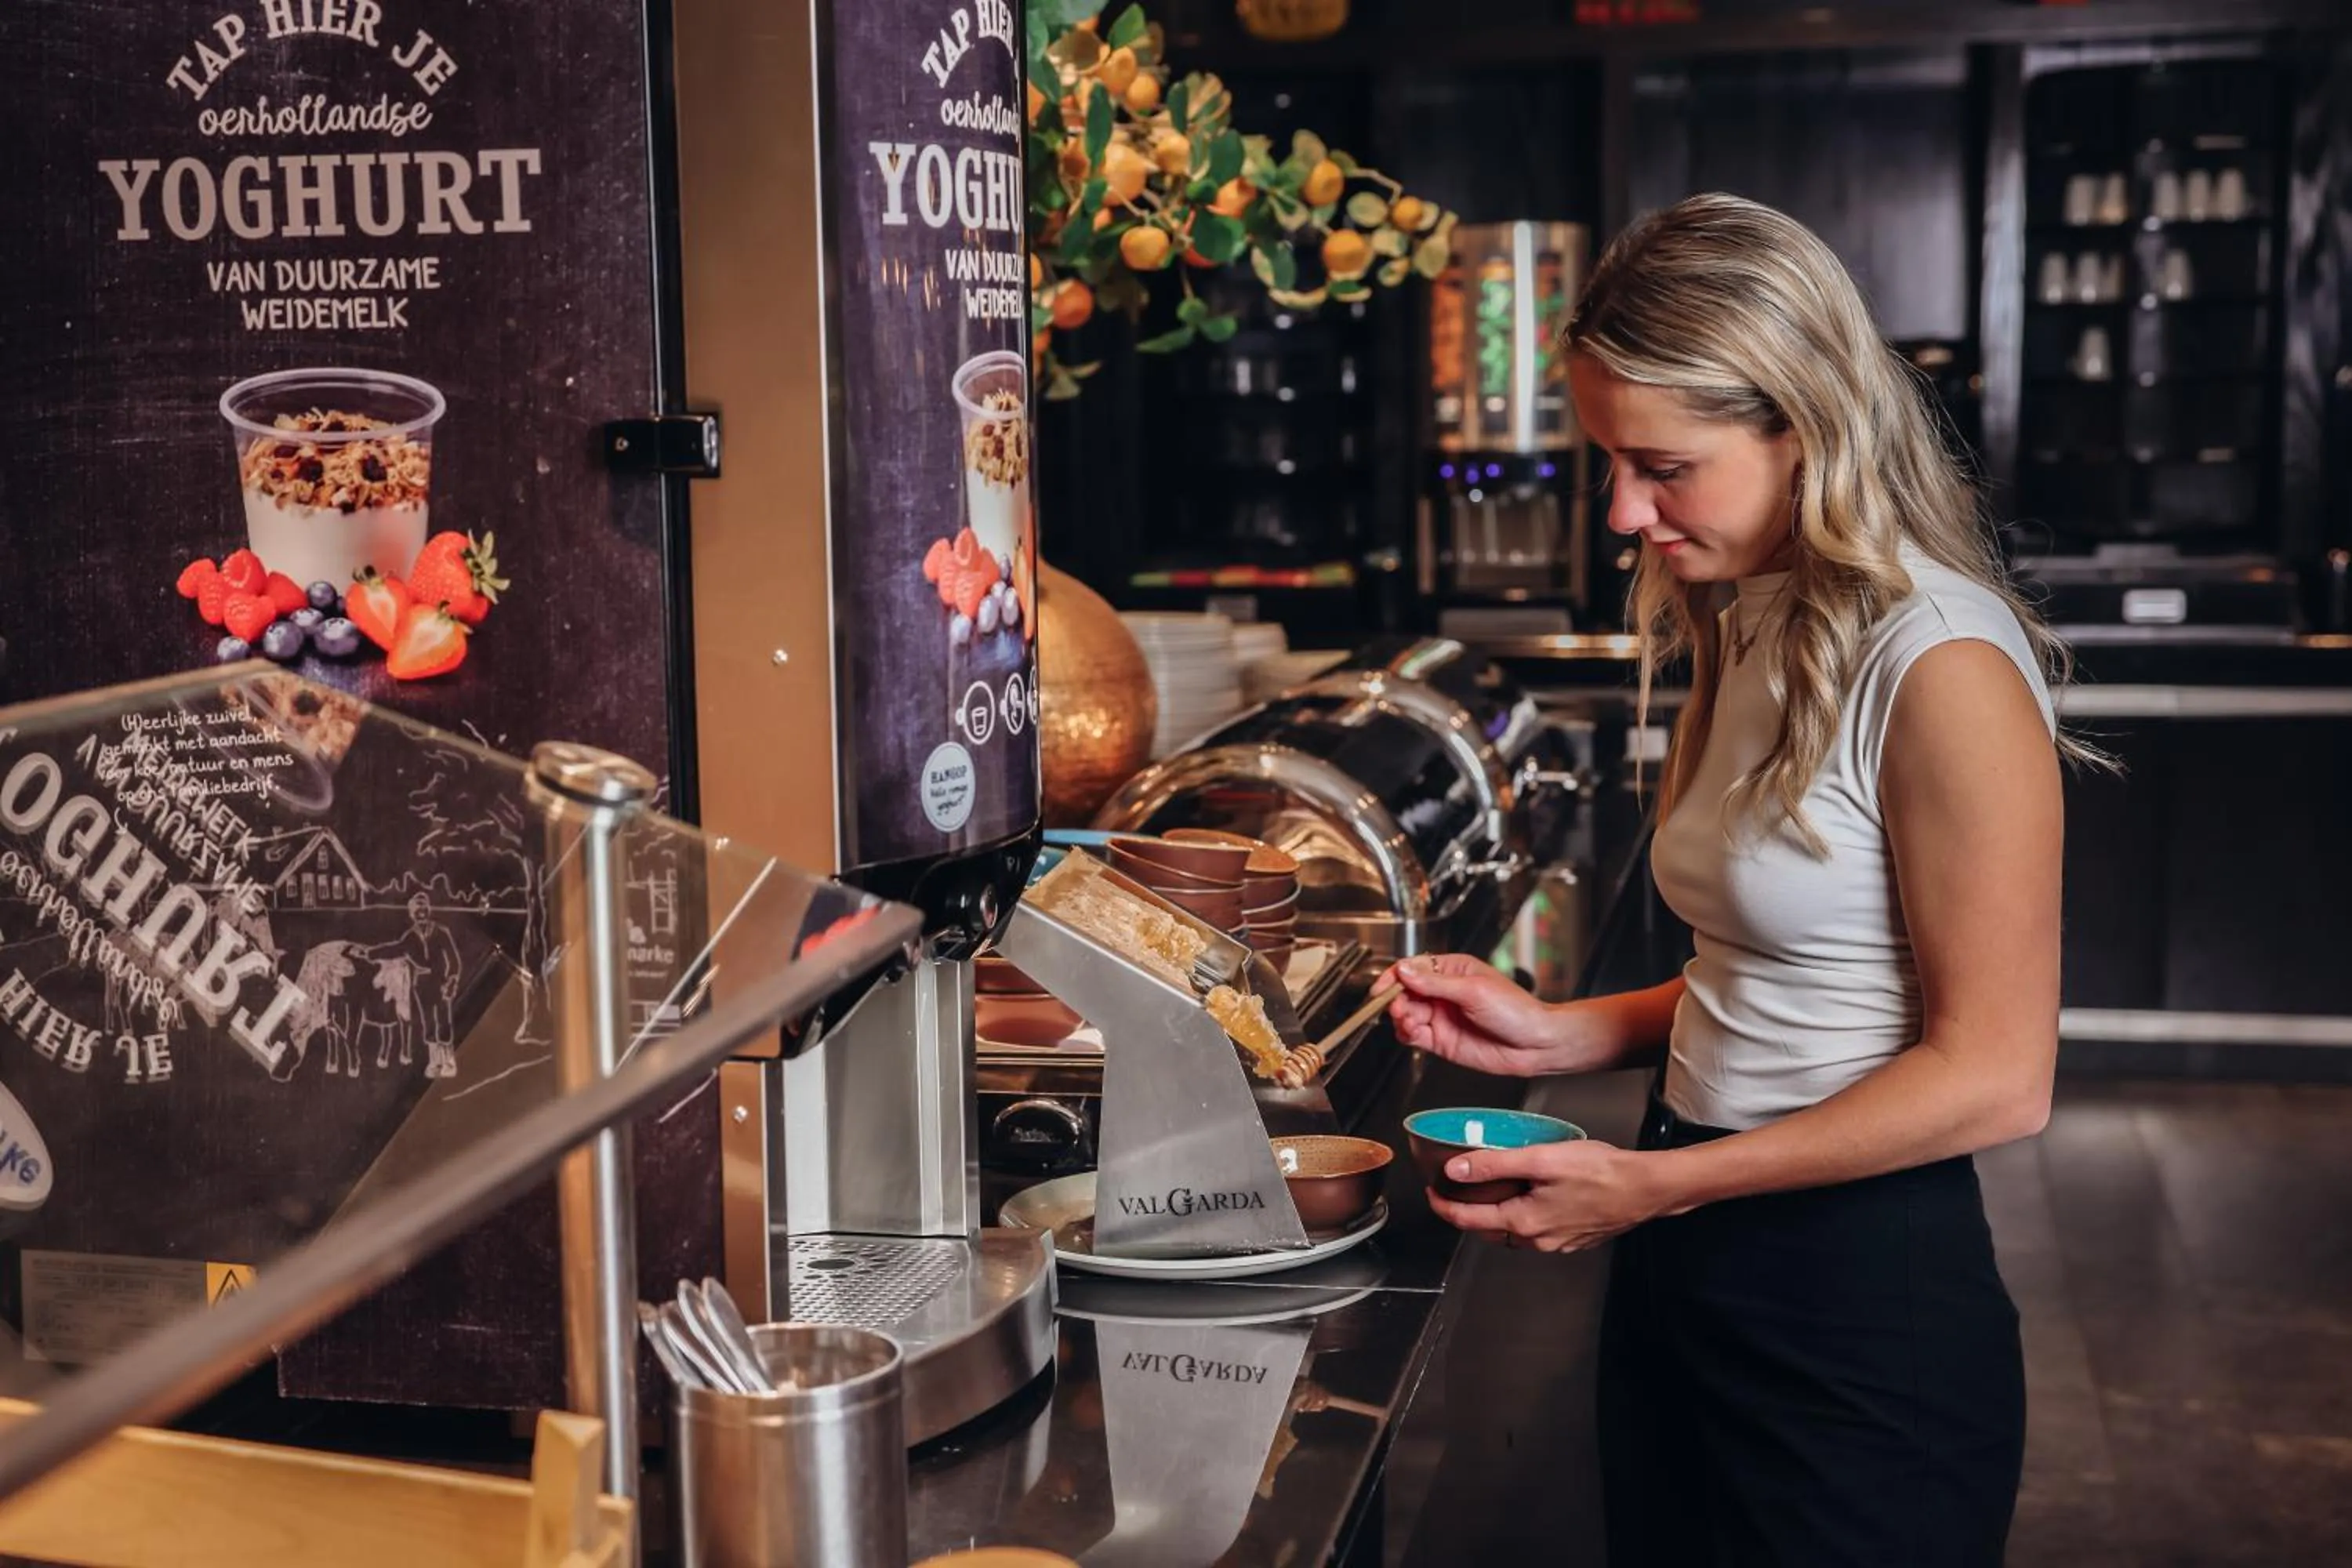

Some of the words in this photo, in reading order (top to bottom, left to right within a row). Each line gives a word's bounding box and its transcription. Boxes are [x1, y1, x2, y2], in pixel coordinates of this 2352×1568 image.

[166, 13, 246, 101] TAP
[260, 0, 380, 48] HIER
[391, 29, 459, 96] JE
[920, 8, 970, 89] TAP
[198, 93, 434, 137] oerhollandse
[98, 148, 542, 241] YOGHURT
[869, 141, 1022, 230] YOGHU
[207, 261, 266, 292] VAN
[274, 257, 441, 292] DUURZAME
[945, 249, 979, 281] VAN
[241, 298, 408, 331] WEIDEMELK
[122, 709, 201, 735] (H)eerlijke
[205, 705, 257, 724] zuivel,
[175, 734, 205, 751] met
[209, 723, 282, 746] aandacht
[229, 757, 249, 770] en
[253, 754, 294, 768] mens
[1119, 1188, 1265, 1216] VALGARDA
